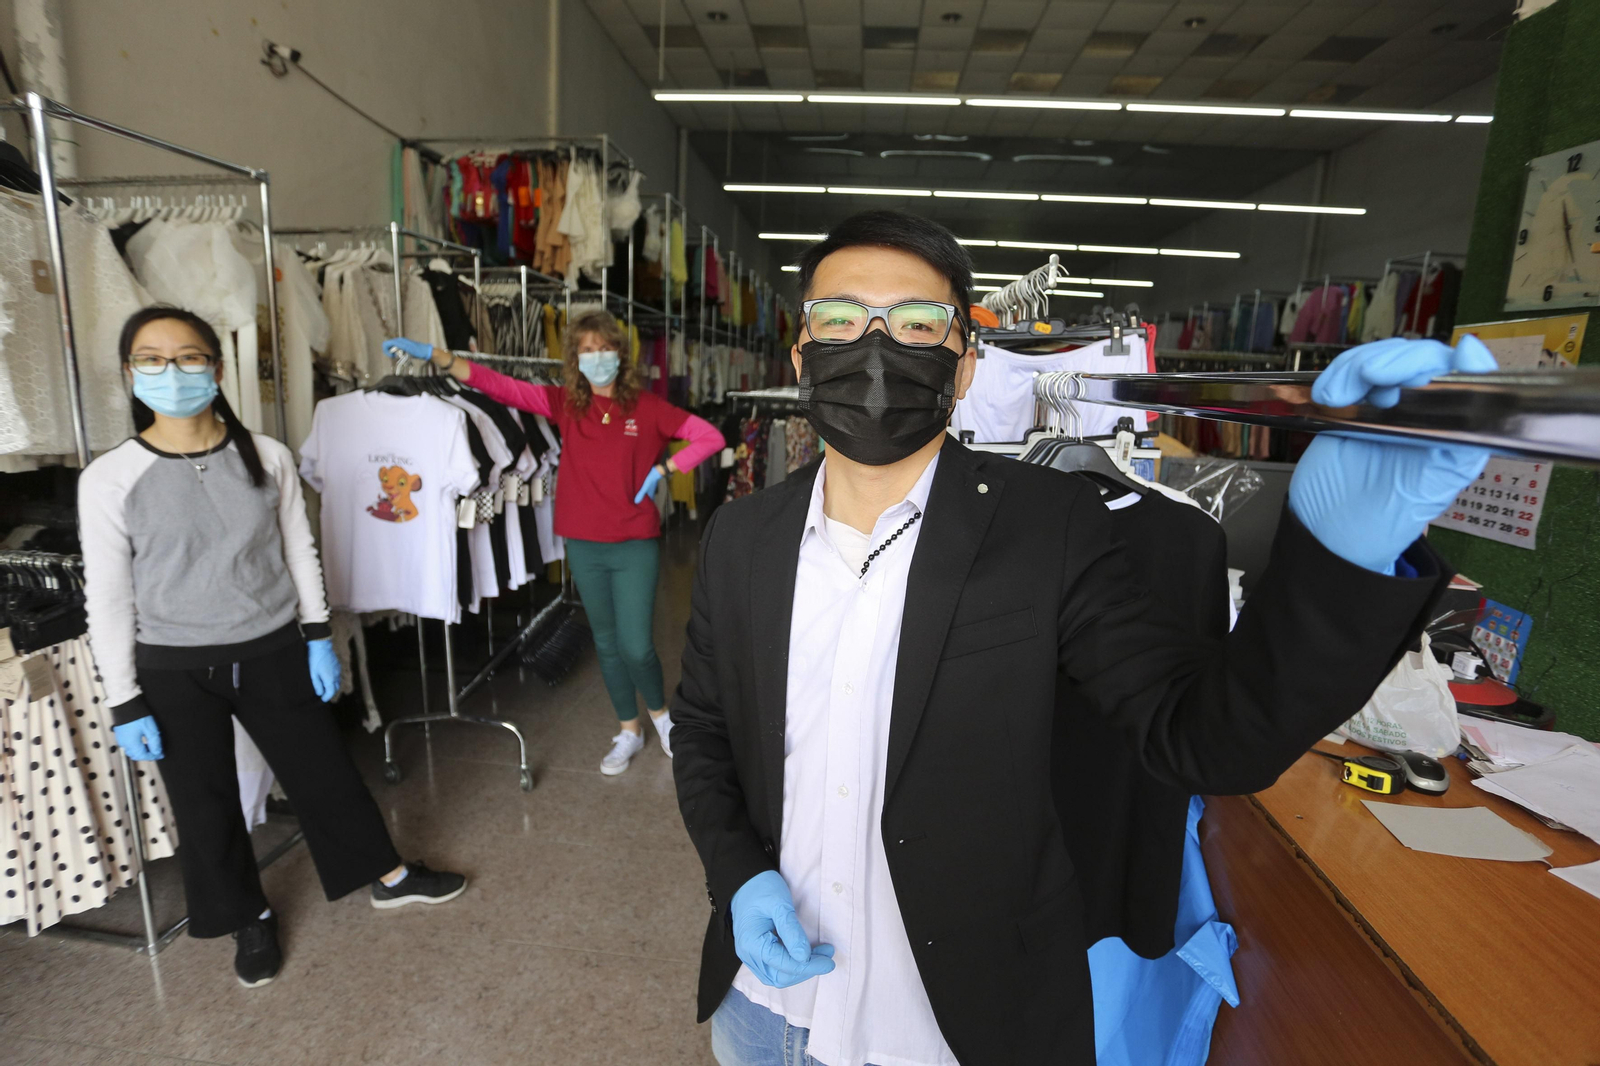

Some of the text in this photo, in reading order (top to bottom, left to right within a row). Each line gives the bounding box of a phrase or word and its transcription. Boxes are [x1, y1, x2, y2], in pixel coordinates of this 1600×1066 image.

[1567, 152, 1583, 173] 12
[1518, 229, 1529, 246] 9
[1543, 285, 1553, 302] 6
[368, 453, 389, 463] LION
[1534, 464, 1541, 472] 1
[1494, 474, 1502, 483] 6
[1511, 477, 1519, 486] 7
[1529, 480, 1537, 489] 8
[1473, 486, 1487, 496] 12
[1489, 489, 1503, 499] 13
[1506, 492, 1520, 502] 14
[1523, 495, 1538, 505] 15
[1455, 498, 1534, 521] 18 19 20 21 22
[1452, 511, 1530, 537] 25 26 27 28 29
[1475, 627, 1482, 636] 7
[1485, 632, 1491, 642] 8
[1496, 637, 1502, 647] 9
[1376, 719, 1402, 729] HORAS
[1367, 733, 1407, 746] FESTIVOS
[1373, 727, 1407, 739] SABADO
